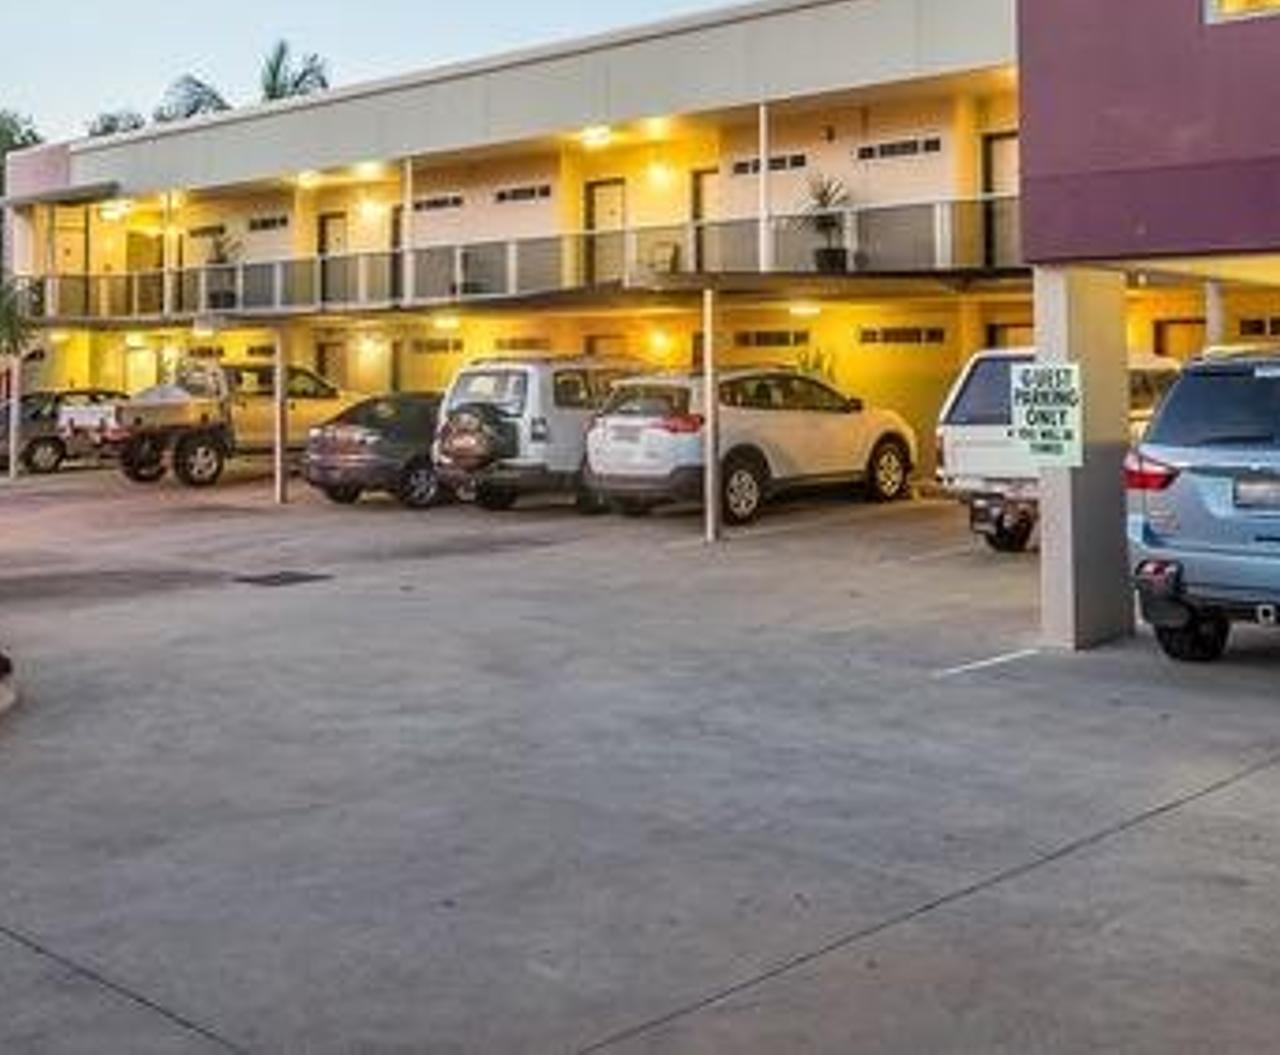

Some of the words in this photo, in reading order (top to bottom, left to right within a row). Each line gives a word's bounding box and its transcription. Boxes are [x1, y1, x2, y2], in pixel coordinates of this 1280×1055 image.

[1021, 368, 1073, 388] GUEST
[1014, 387, 1079, 407] PARKING
[1026, 407, 1068, 426] ONLY
